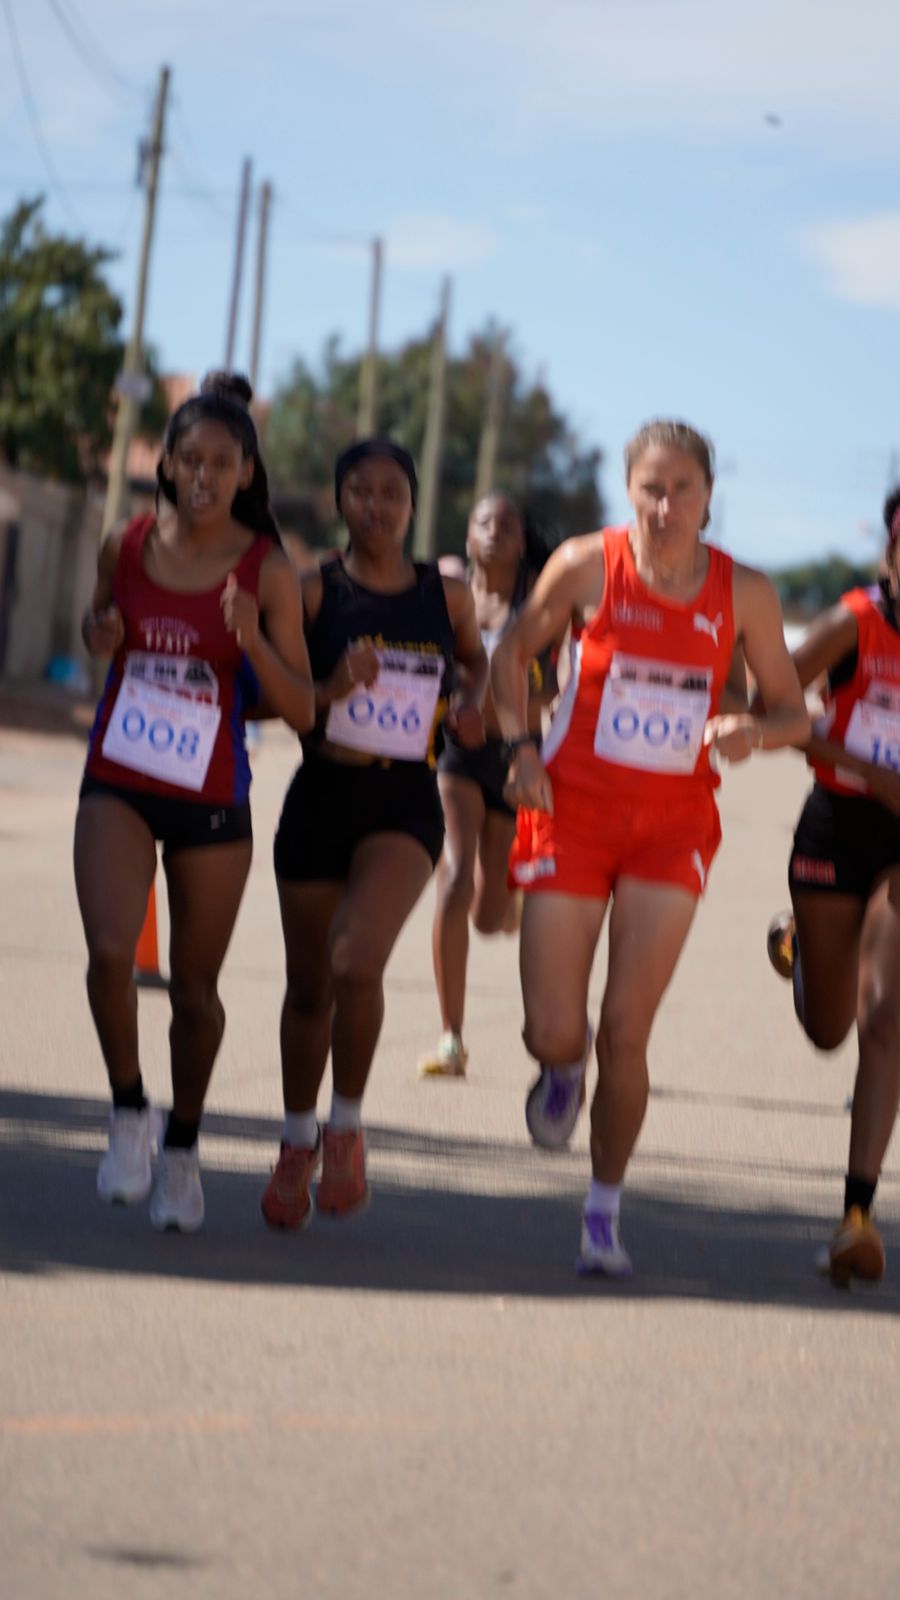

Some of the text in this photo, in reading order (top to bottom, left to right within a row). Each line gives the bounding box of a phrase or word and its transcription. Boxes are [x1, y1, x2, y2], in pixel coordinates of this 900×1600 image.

[122, 706, 199, 763] 008
[347, 693, 421, 736] 066
[612, 704, 692, 752] 005
